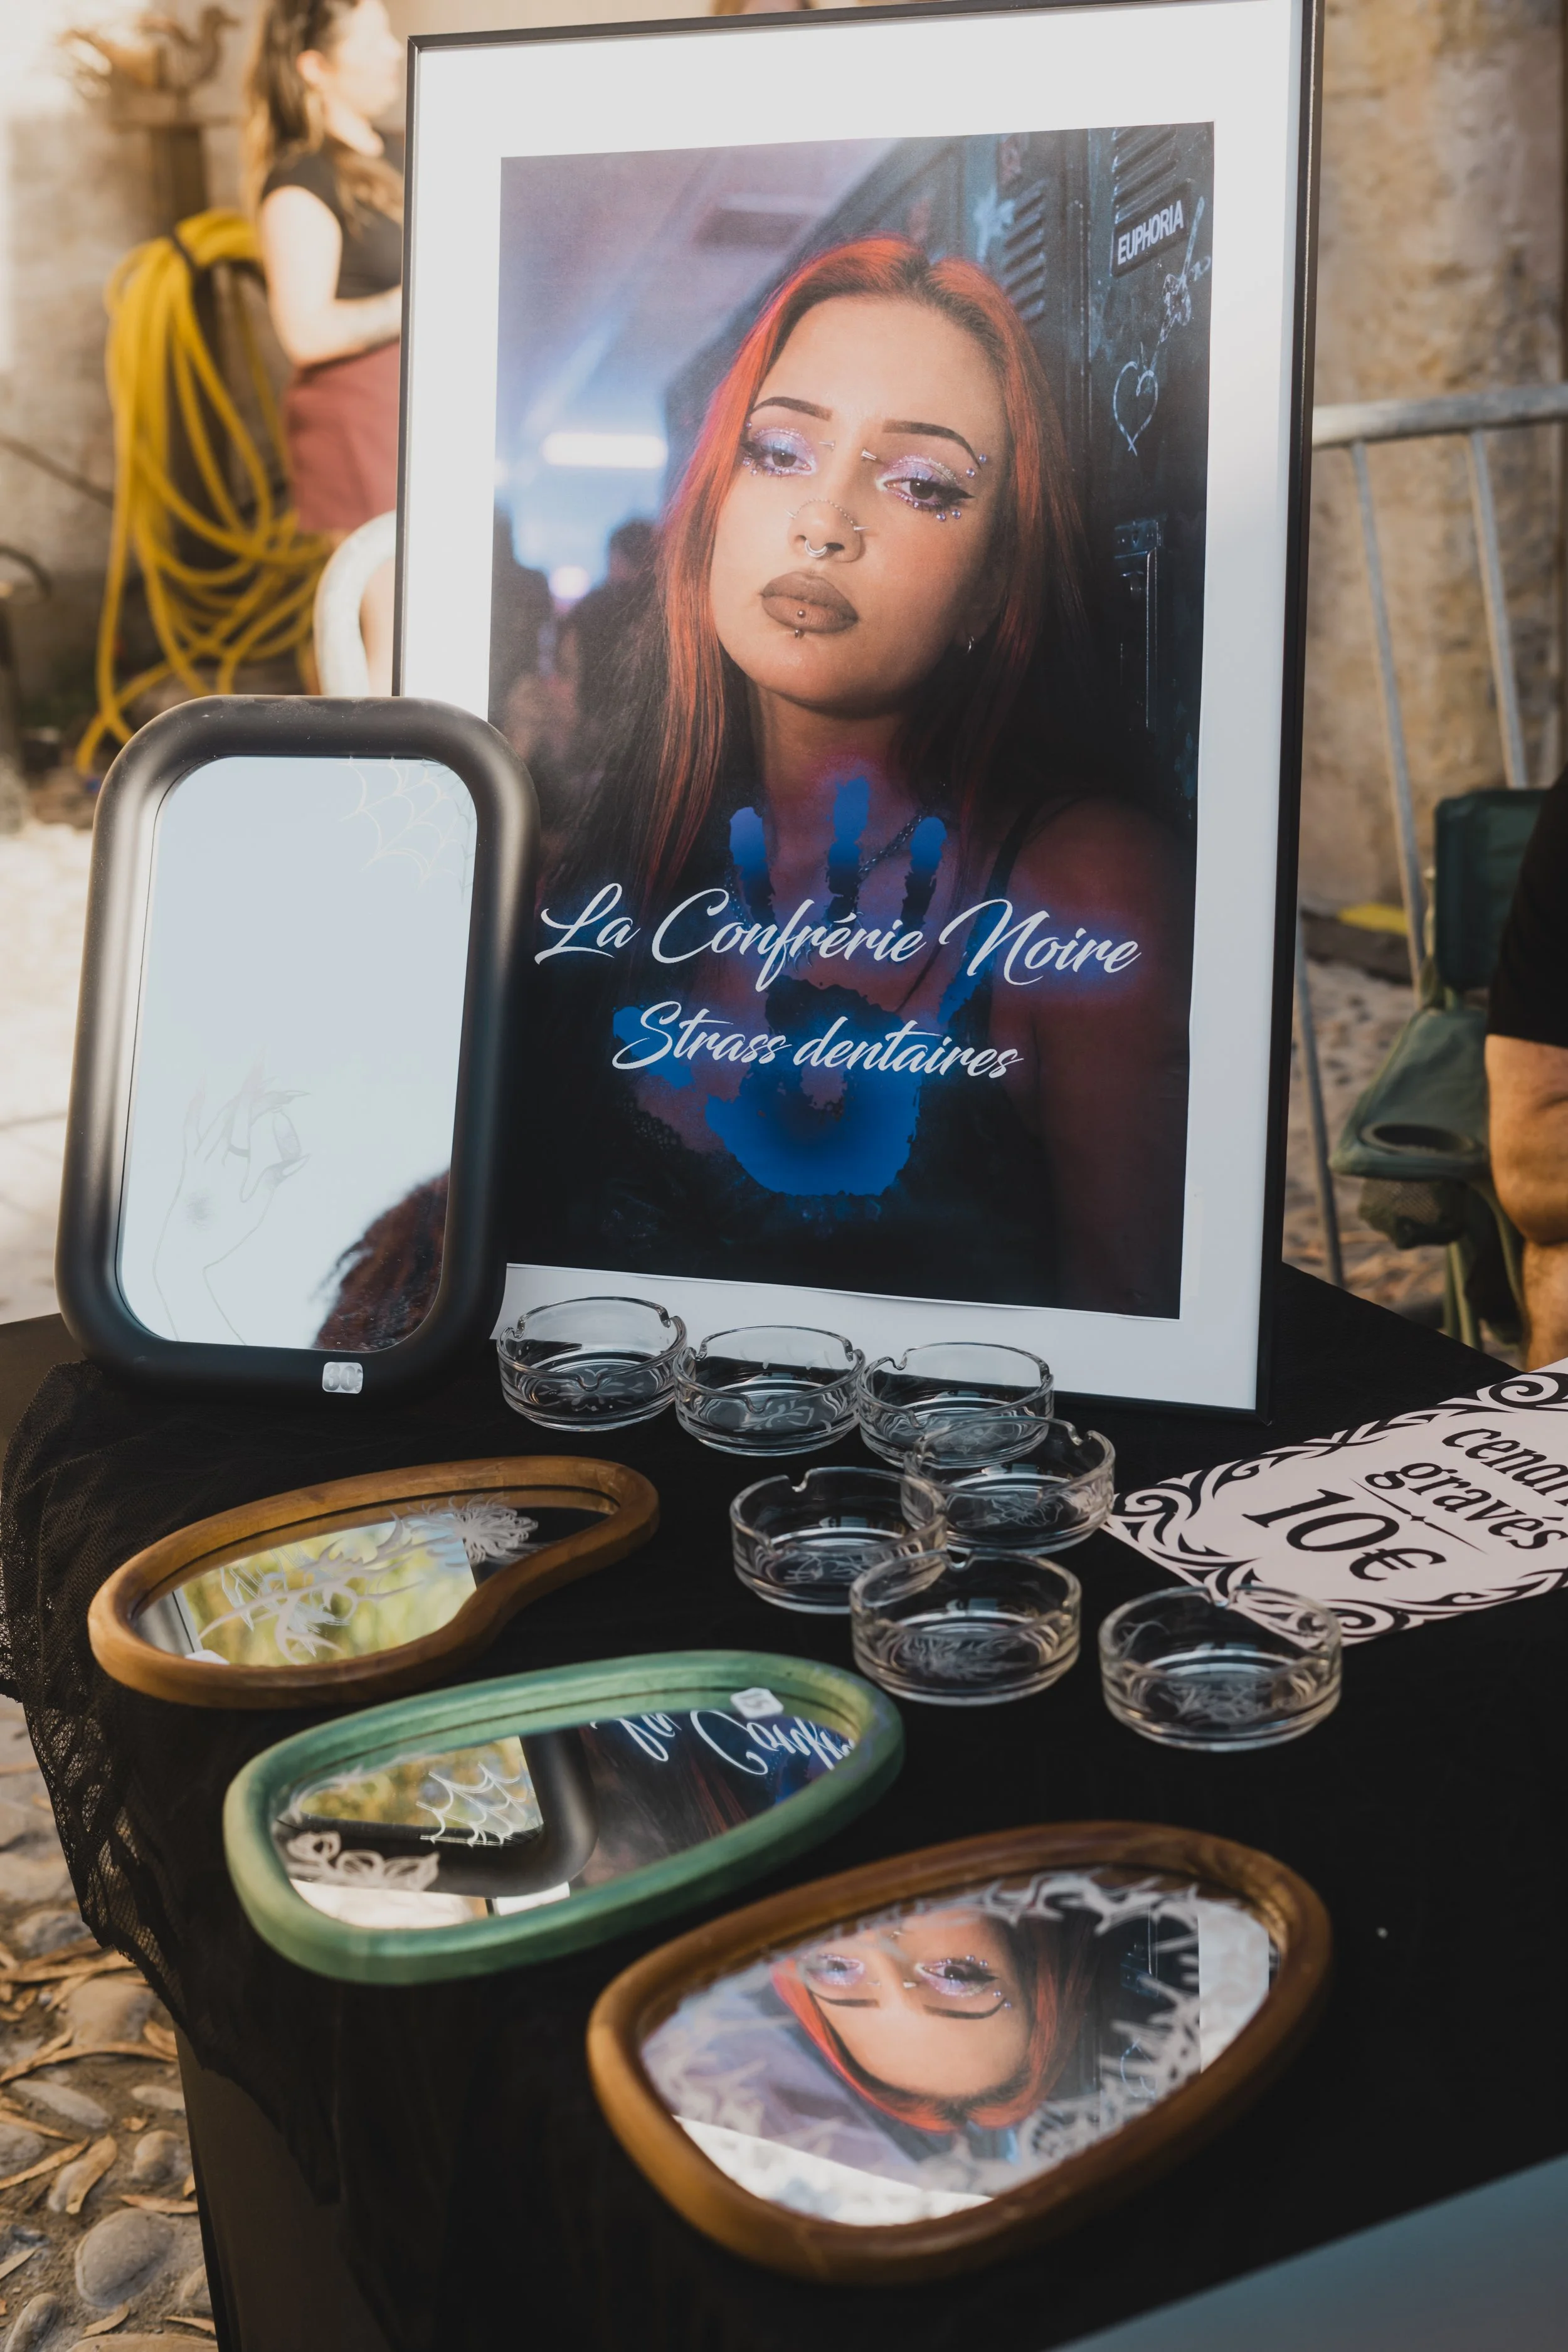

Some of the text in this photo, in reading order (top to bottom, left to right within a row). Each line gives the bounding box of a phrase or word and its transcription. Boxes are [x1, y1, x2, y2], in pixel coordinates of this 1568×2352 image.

[1117, 199, 1184, 265] EUPHORIA
[535, 883, 1142, 992] La Confrérie Noire
[612, 1001, 1025, 1078] Strass dentaires
[1242, 1489, 1446, 1581] 10€
[1365, 1463, 1568, 1549] gravés
